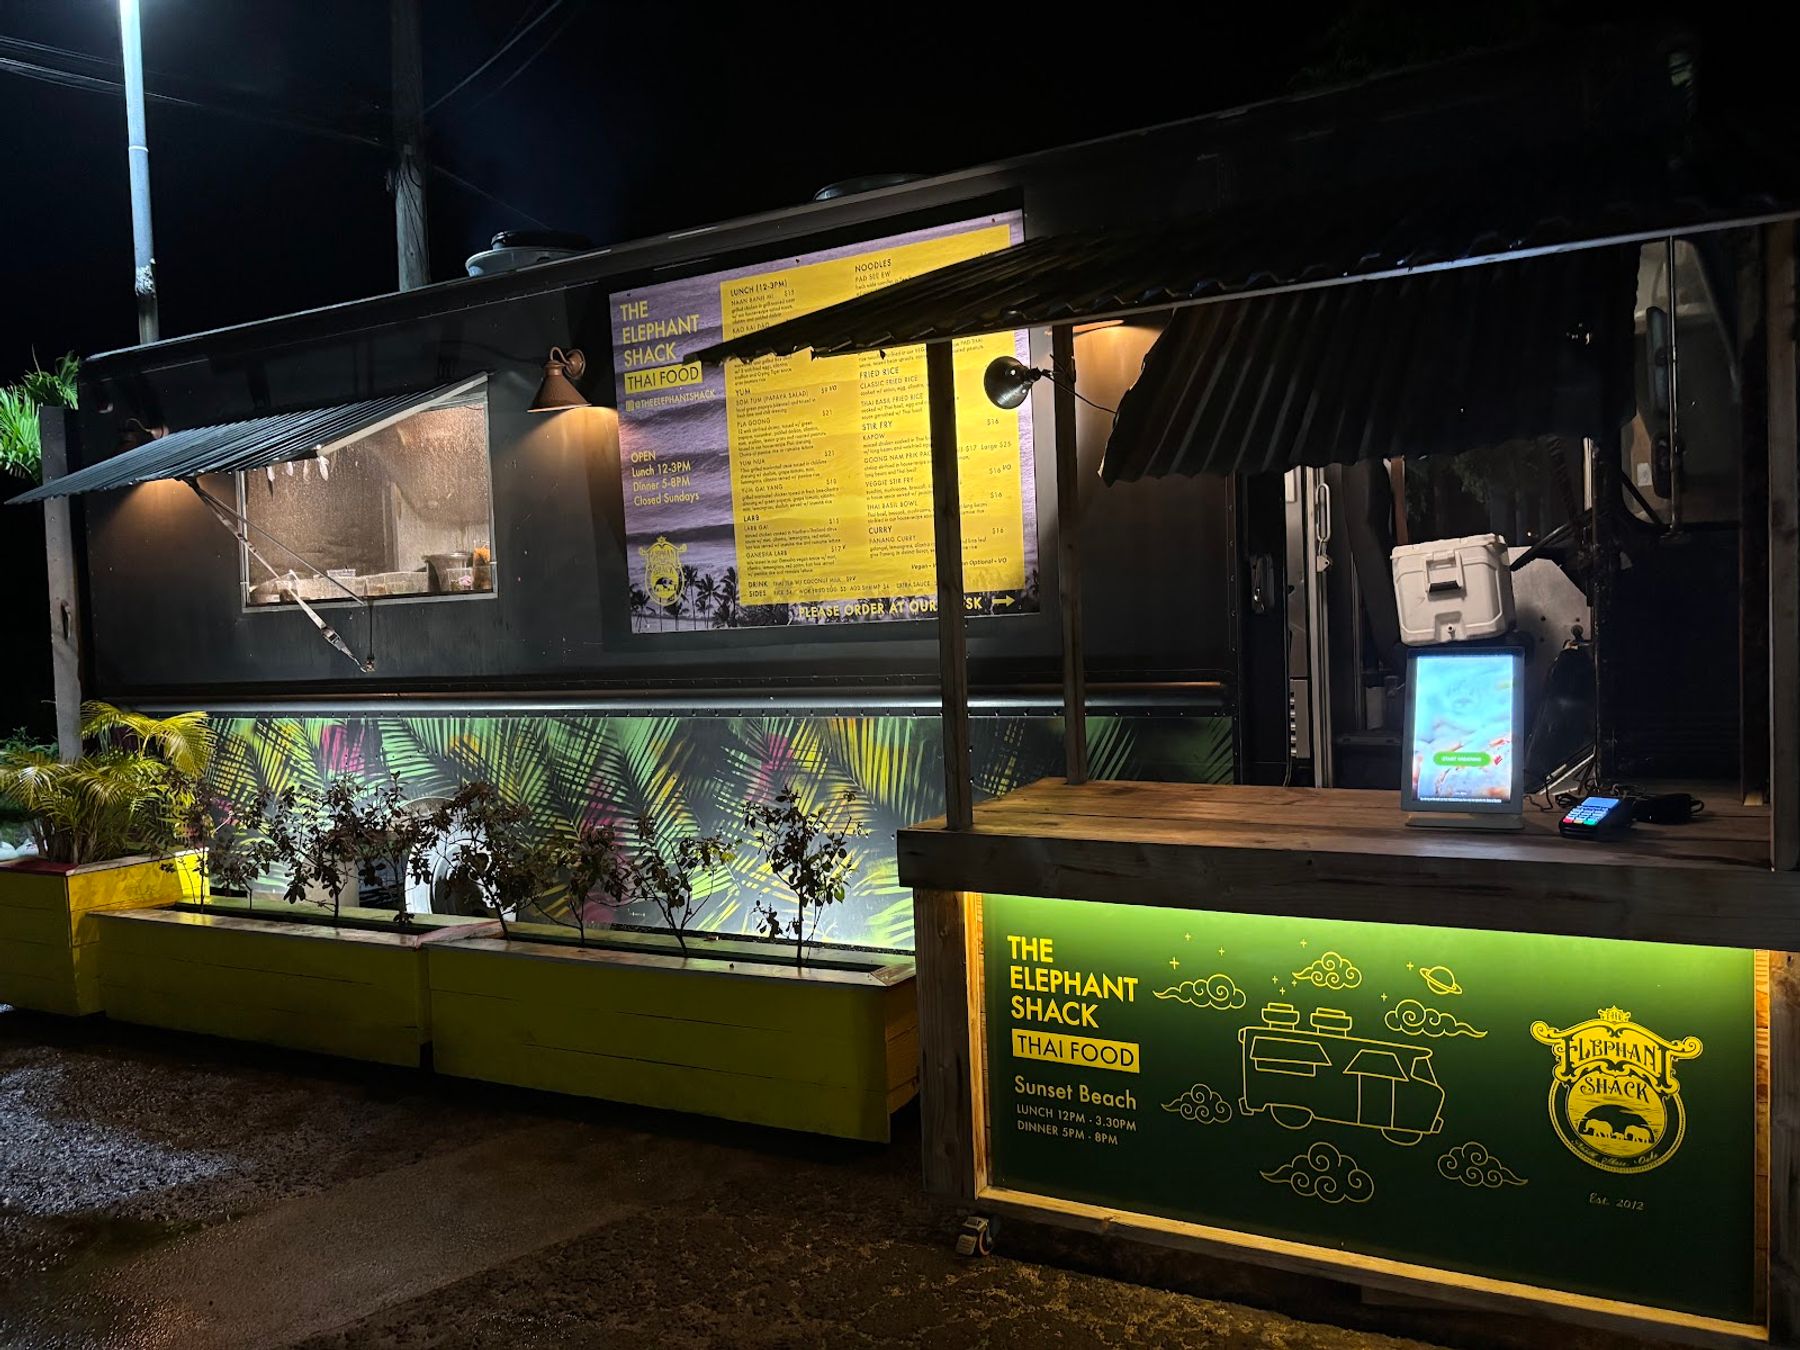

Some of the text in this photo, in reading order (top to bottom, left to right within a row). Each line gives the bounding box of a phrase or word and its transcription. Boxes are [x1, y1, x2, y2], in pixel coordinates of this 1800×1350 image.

[855, 258, 891, 272] NOODLES
[730, 278, 787, 296] LUNCH (12-3PM)
[619, 300, 648, 321] THE
[622, 314, 699, 345] ELEPHANT
[623, 341, 676, 368] SHACK
[627, 366, 698, 390] THAI FOOD
[859, 366, 899, 378] FRIED RICE
[735, 388, 750, 396] YUM
[860, 380, 884, 389] CLASSIC
[886, 377, 902, 385] FRIED
[862, 420, 892, 430] STIR FRY
[987, 417, 998, 425] $16
[631, 451, 655, 462] OPEN
[864, 455, 887, 463] GOONG
[981, 442, 997, 451] Large
[632, 460, 690, 477] Lunch 12-3PM
[865, 479, 886, 487] VEGGIE
[989, 466, 1000, 474] $16
[633, 475, 690, 491] Dinner 5-8PM
[634, 489, 699, 505] Closed Sundays
[868, 525, 892, 534] CURRY
[799, 605, 839, 617] PLEASE
[844, 603, 884, 616] ORDER
[888, 602, 907, 613] AT
[909, 600, 937, 612] OUR
[1007, 935, 1054, 963] THE
[1010, 965, 1138, 1002] ELEPHANT
[1011, 996, 1099, 1028] SHACK
[1017, 1035, 1134, 1067] THAI FOOD
[1562, 1034, 1672, 1088] ELEPHANT
[1014, 1075, 1136, 1110] Sunset Beach
[1580, 1077, 1649, 1103] SHACK
[1016, 1103, 1053, 1118] LUNCH
[1057, 1110, 1086, 1124] 12PM
[1095, 1115, 1137, 1131] 3.30PM
[1017, 1120, 1058, 1136] DINNER
[1062, 1127, 1085, 1140] 5PM
[1094, 1133, 1119, 1145] 8PM
[1616, 1199, 1645, 1211] 2012
